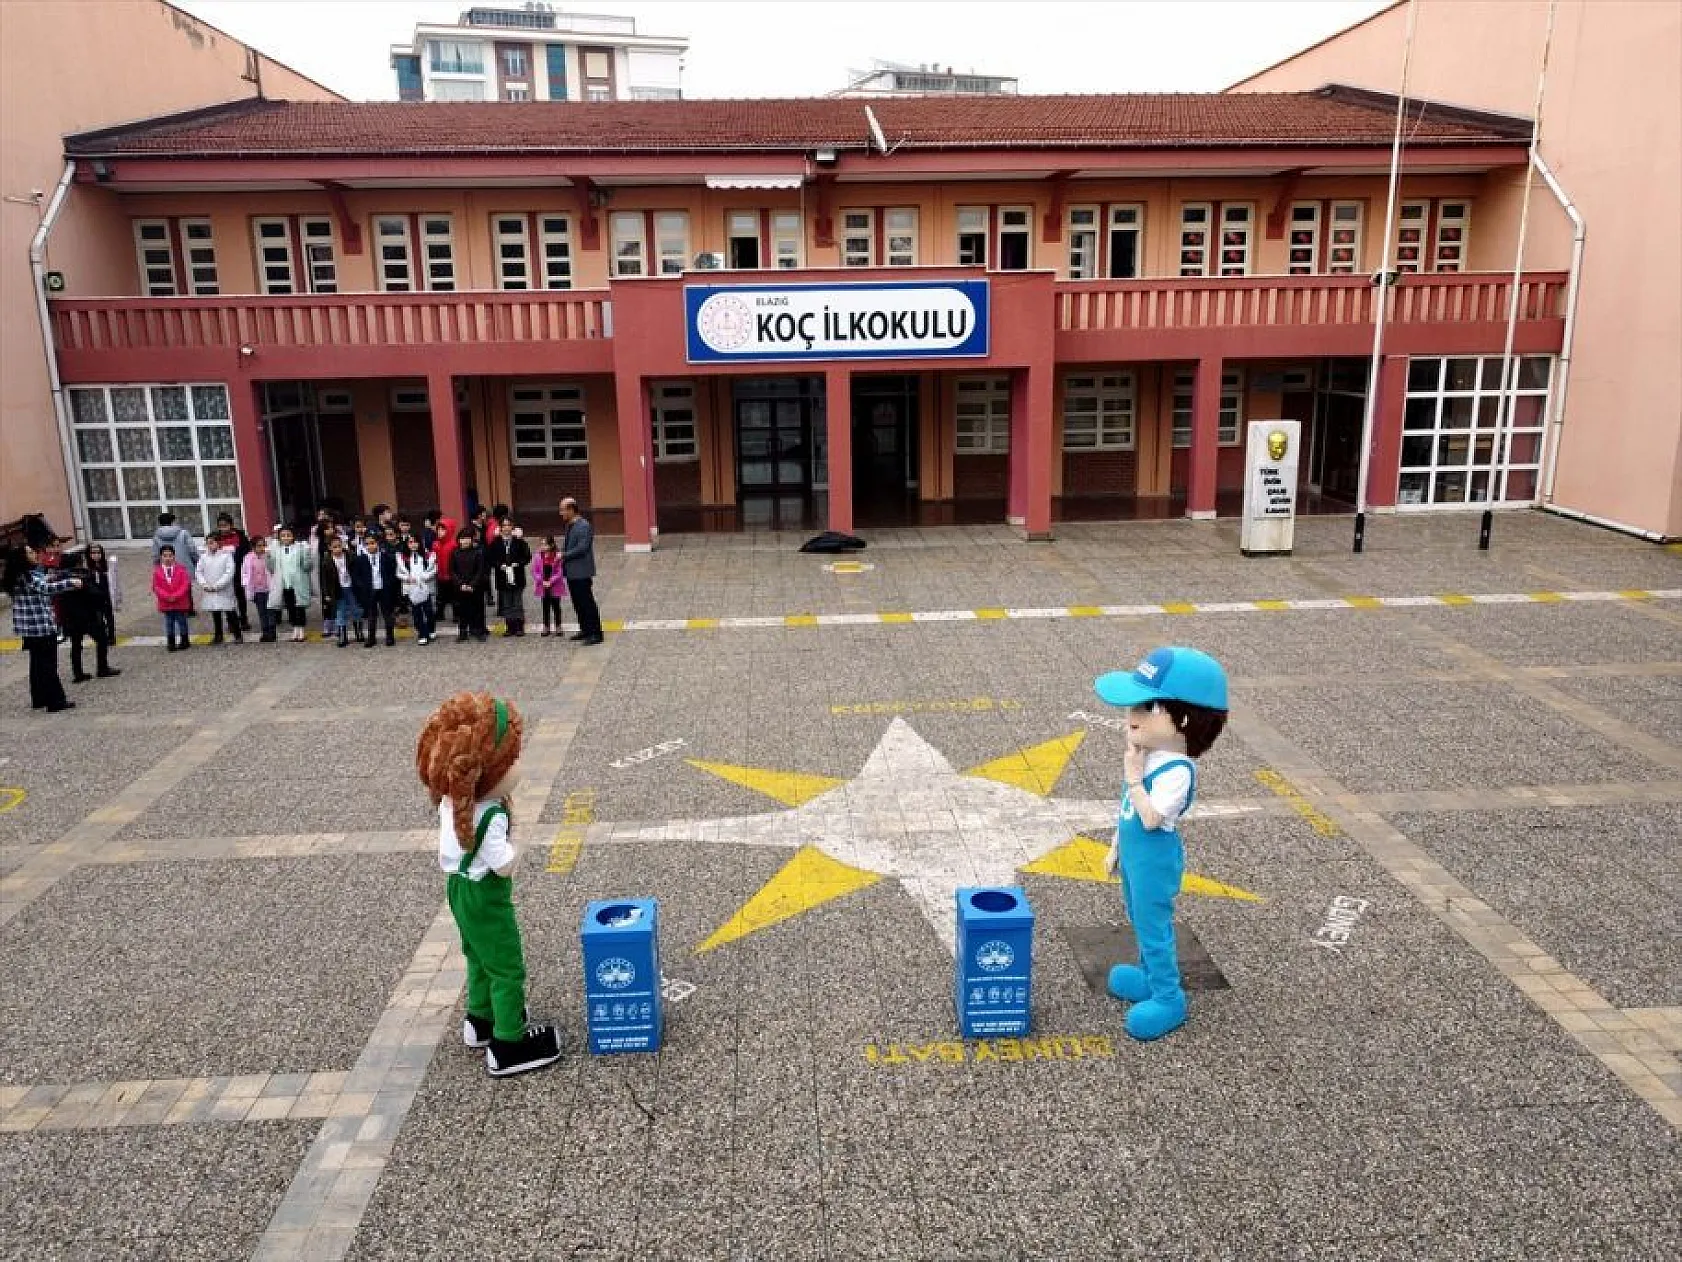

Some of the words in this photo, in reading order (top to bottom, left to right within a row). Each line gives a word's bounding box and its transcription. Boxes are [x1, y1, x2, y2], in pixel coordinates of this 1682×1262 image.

[755, 296, 788, 306] ELAZIĞ
[756, 312, 815, 350] KOÇ
[823, 305, 967, 341] İLKOKULU
